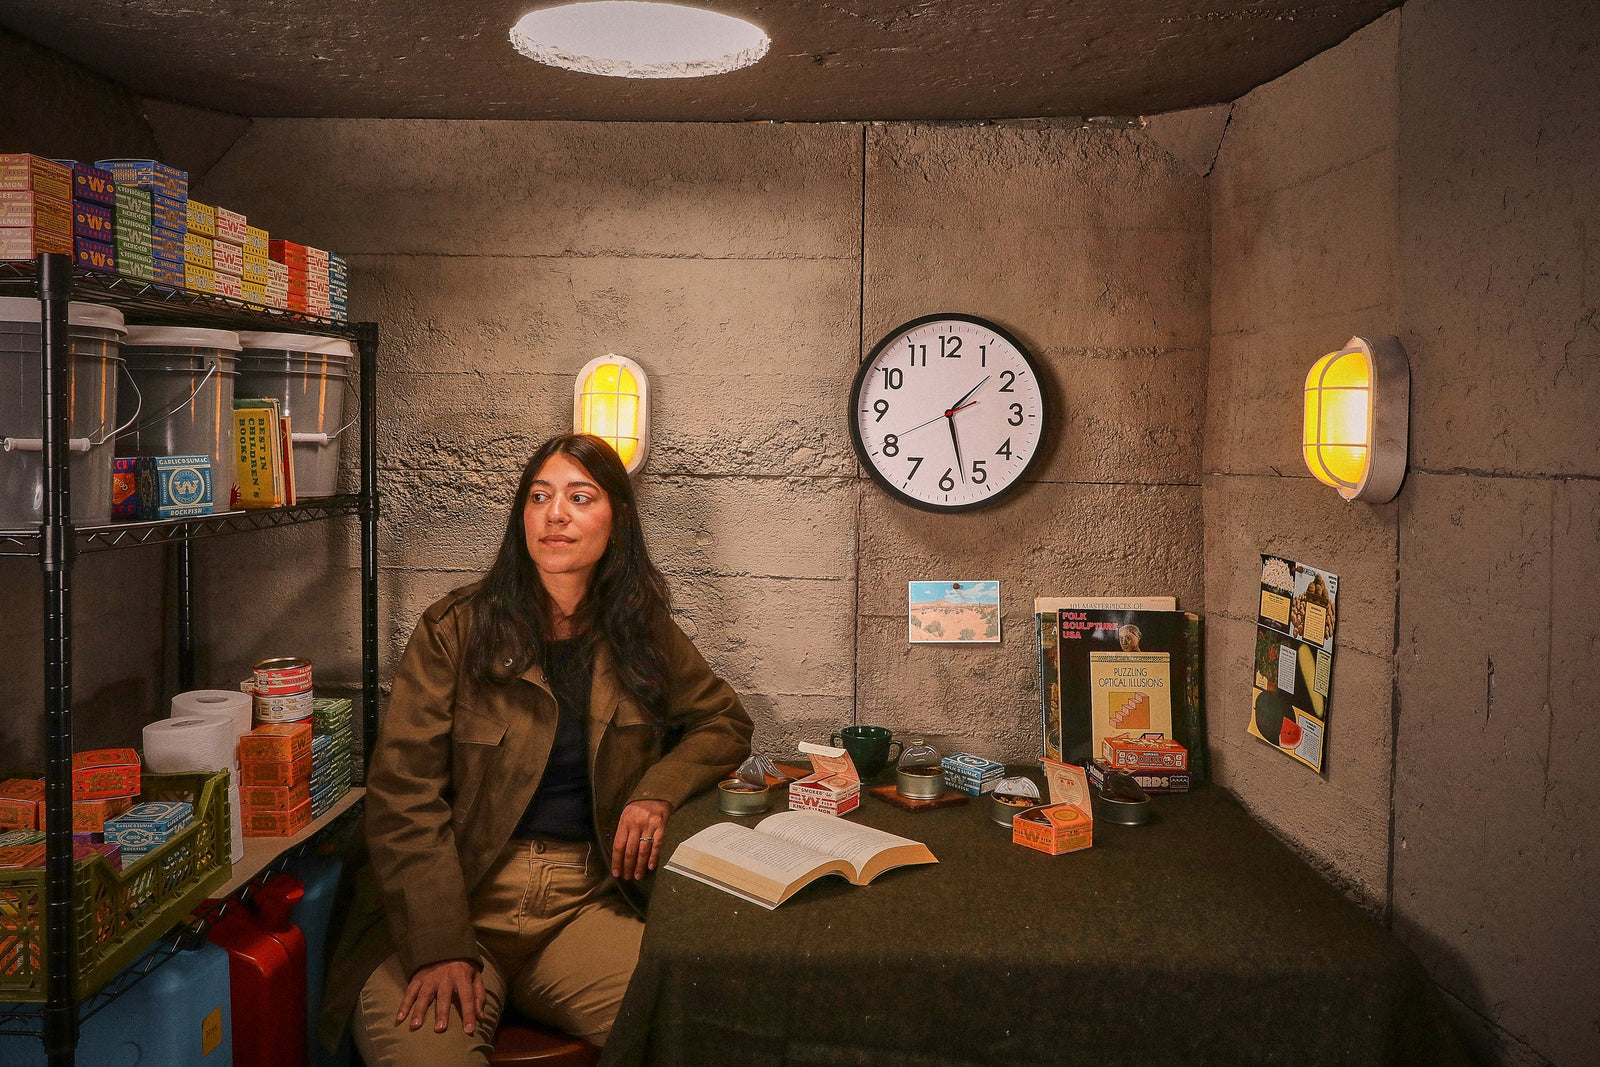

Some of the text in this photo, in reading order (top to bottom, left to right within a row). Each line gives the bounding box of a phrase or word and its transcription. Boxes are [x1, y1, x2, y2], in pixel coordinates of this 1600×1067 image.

[87, 175, 106, 193] W
[86, 213, 103, 231] W
[193, 210, 207, 226] W
[227, 219, 240, 233] W
[251, 235, 262, 249] W
[89, 250, 106, 267] W
[192, 244, 204, 258] W
[223, 251, 235, 265] W
[251, 263, 262, 275] W
[315, 257, 325, 267] W
[195, 275, 208, 290] W
[223, 282, 235, 296] W
[316, 281, 325, 292] W
[248, 290, 260, 303] W
[938, 335, 963, 358] 12
[908, 344, 927, 367] 11
[979, 345, 986, 367] 1
[882, 367, 904, 390] 10
[998, 370, 1016, 392] 2
[874, 399, 890, 423] 9
[1007, 402, 1024, 427] 3
[238, 418, 247, 463] BOOKS
[258, 418, 268, 474] BEST IN
[882, 433, 900, 457] 8
[995, 436, 1013, 461] 4
[248, 418, 262, 499] CHILDREN'S
[907, 456, 925, 480] 7
[971, 460, 987, 484] 5
[173, 480, 199, 494] W
[938, 467, 955, 492] 6
[170, 508, 203, 516] ROCKFISH
[1062, 612, 1087, 620] FOLK
[1062, 622, 1118, 631] SCULPTURE
[1062, 631, 1082, 639] USA
[1113, 667, 1148, 677] PUZZLING
[1098, 677, 1164, 688] OPTICAL ILLUSIONS
[801, 795, 821, 807] W
[1023, 828, 1043, 843] W
